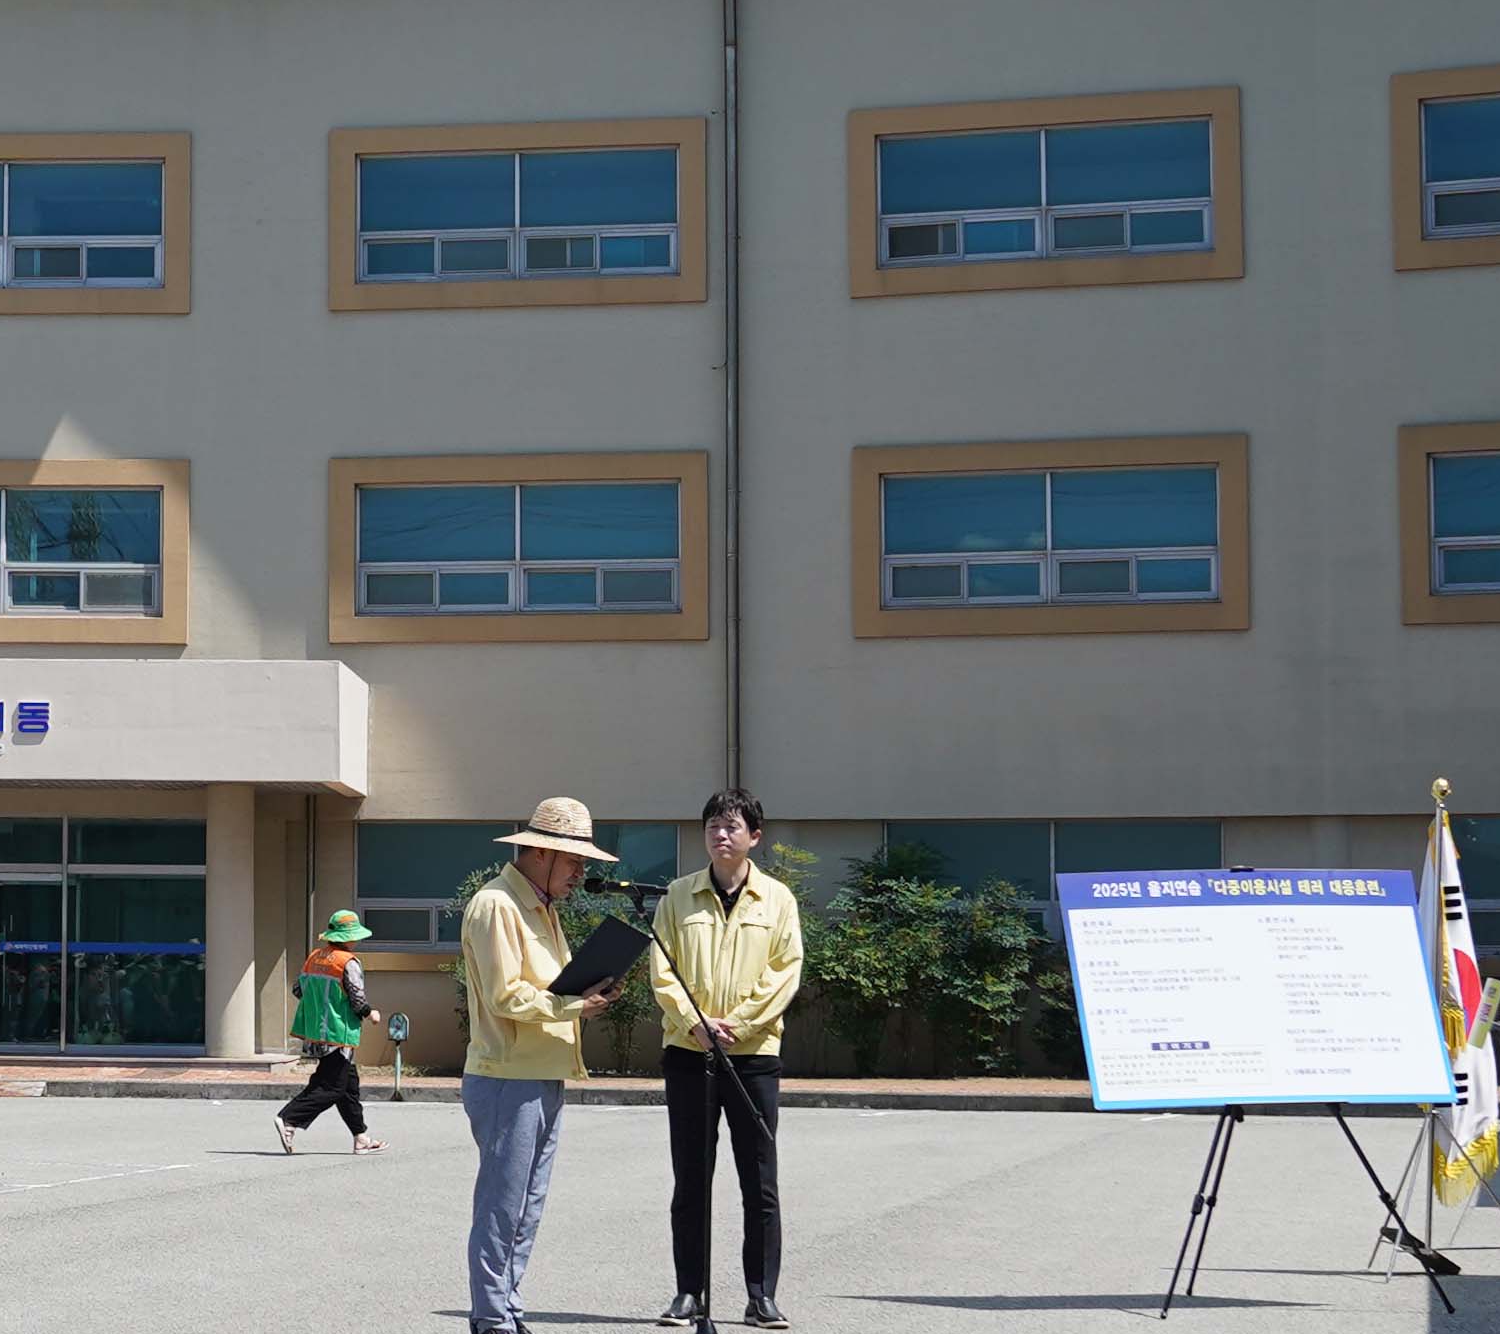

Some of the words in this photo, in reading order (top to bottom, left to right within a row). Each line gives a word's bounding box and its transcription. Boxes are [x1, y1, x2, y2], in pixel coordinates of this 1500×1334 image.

[1092, 881, 1142, 898] 2025년
[1147, 880, 1202, 898] 을지연습
[1297, 878, 1325, 896] 테러
